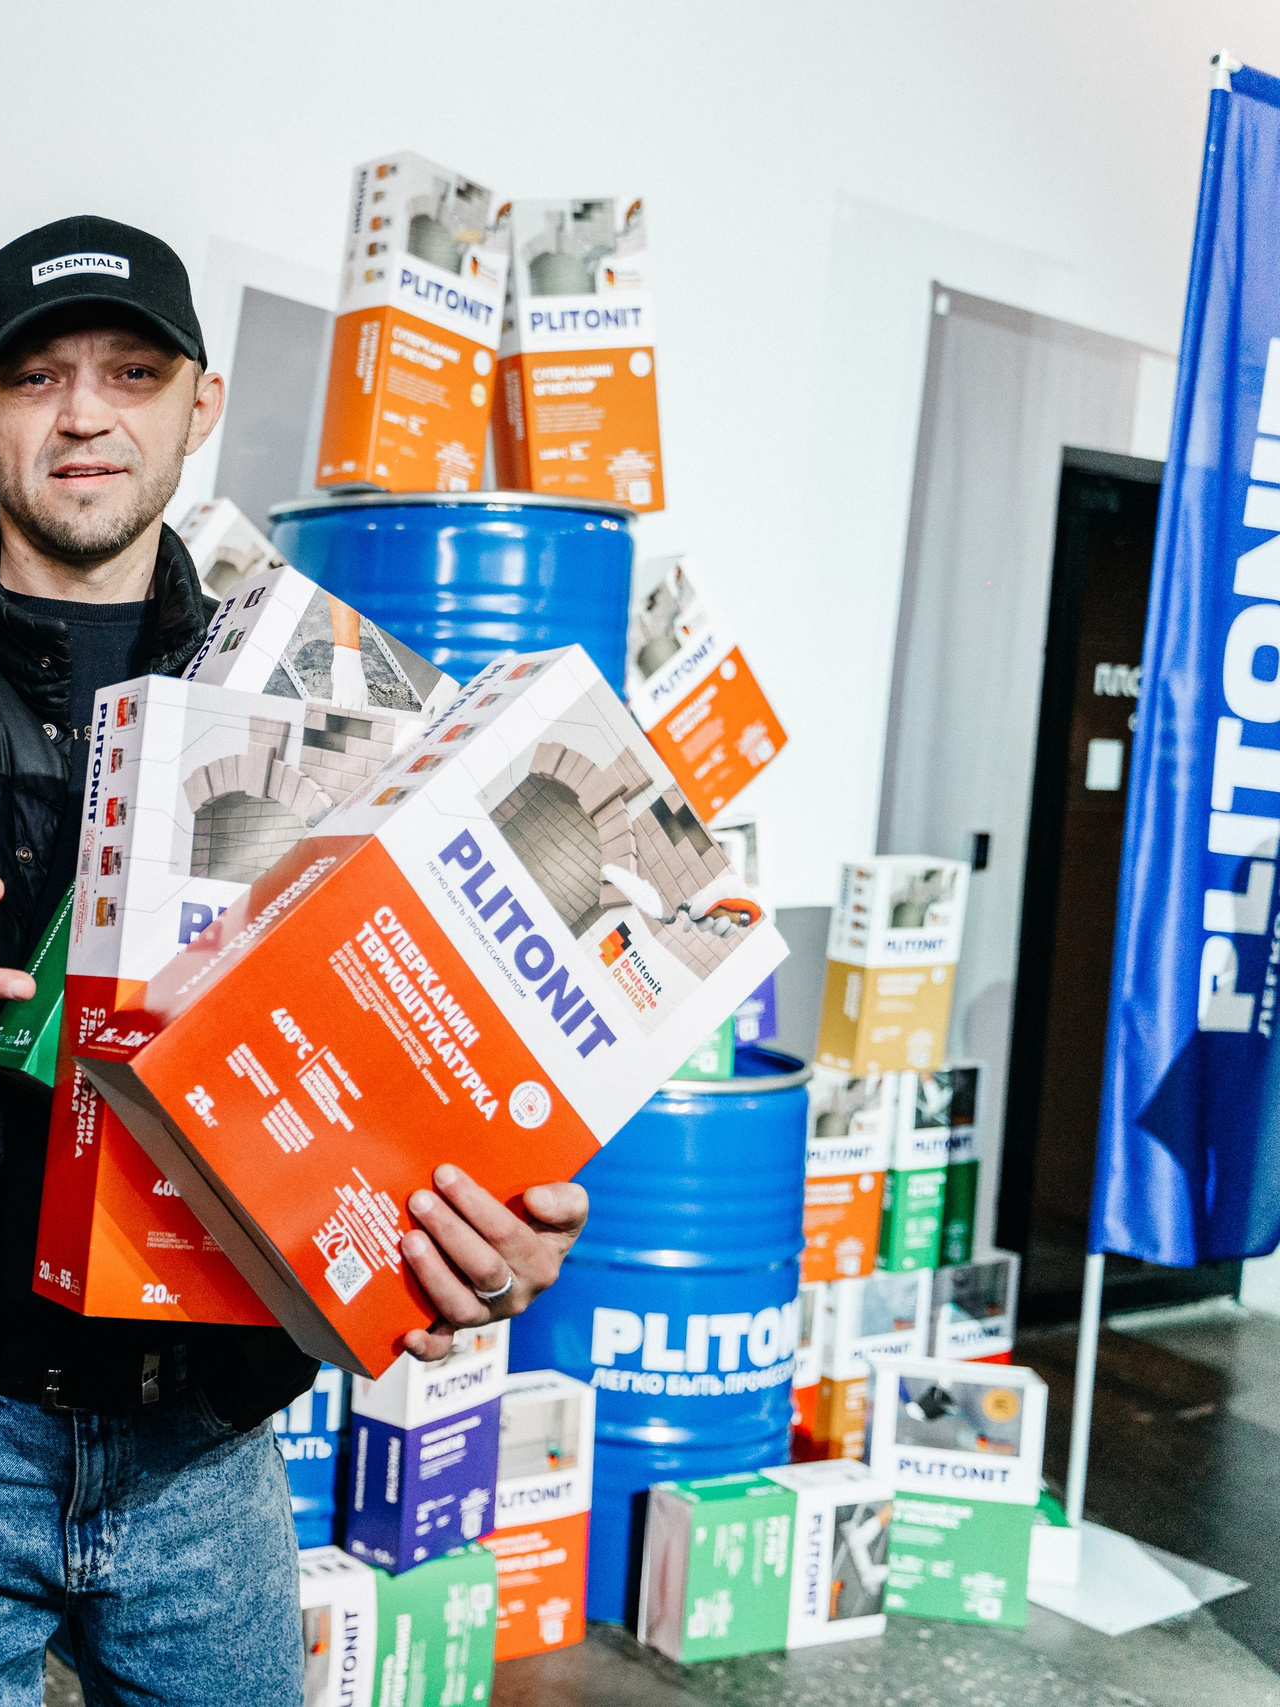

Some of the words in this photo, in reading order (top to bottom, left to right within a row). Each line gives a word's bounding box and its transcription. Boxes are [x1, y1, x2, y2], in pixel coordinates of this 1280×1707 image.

[37, 257, 124, 277] ESSENTIALS
[530, 307, 642, 332] PLITONIT
[88, 701, 108, 824] PLITONIT
[426, 861, 449, 890] ЛЕГКО
[447, 890, 465, 915] БЫТЬ
[467, 916, 526, 998] ПРОФЕССИОНАЛОМ
[438, 828, 617, 1059] PLITONIT
[333, 963, 370, 1010] дымоходов
[374, 906, 479, 1047] СУПЕРКАМИН
[613, 968, 645, 1012] Qualität
[620, 959, 657, 1008] Deutsche
[629, 950, 661, 995] Plitonit
[334, 949, 350, 967] для
[348, 966, 403, 1040] оштукатуривания
[421, 1068, 449, 1104] каминов
[342, 941, 366, 972] Белый
[364, 971, 408, 1030] термостойкий
[403, 1030, 431, 1064] раствор
[355, 922, 499, 1120] ТЕРМОШТУКАТУРКА
[271, 1008, 313, 1059] 400°C
[324, 1051, 348, 1081] БЕЛЫЙ
[343, 1078, 362, 1100] ЦВЕТ
[342, 1184, 367, 1216] ПЕЧЕЙ
[368, 1219, 401, 1265] КАМИНОВ
[358, 1187, 399, 1246] ВОЗВЕДЕНИЕ
[280, 1436, 332, 1460] ЫТЬ
[898, 1458, 1010, 1483] PLITONIT
[498, 1482, 572, 1508] LITONIT
